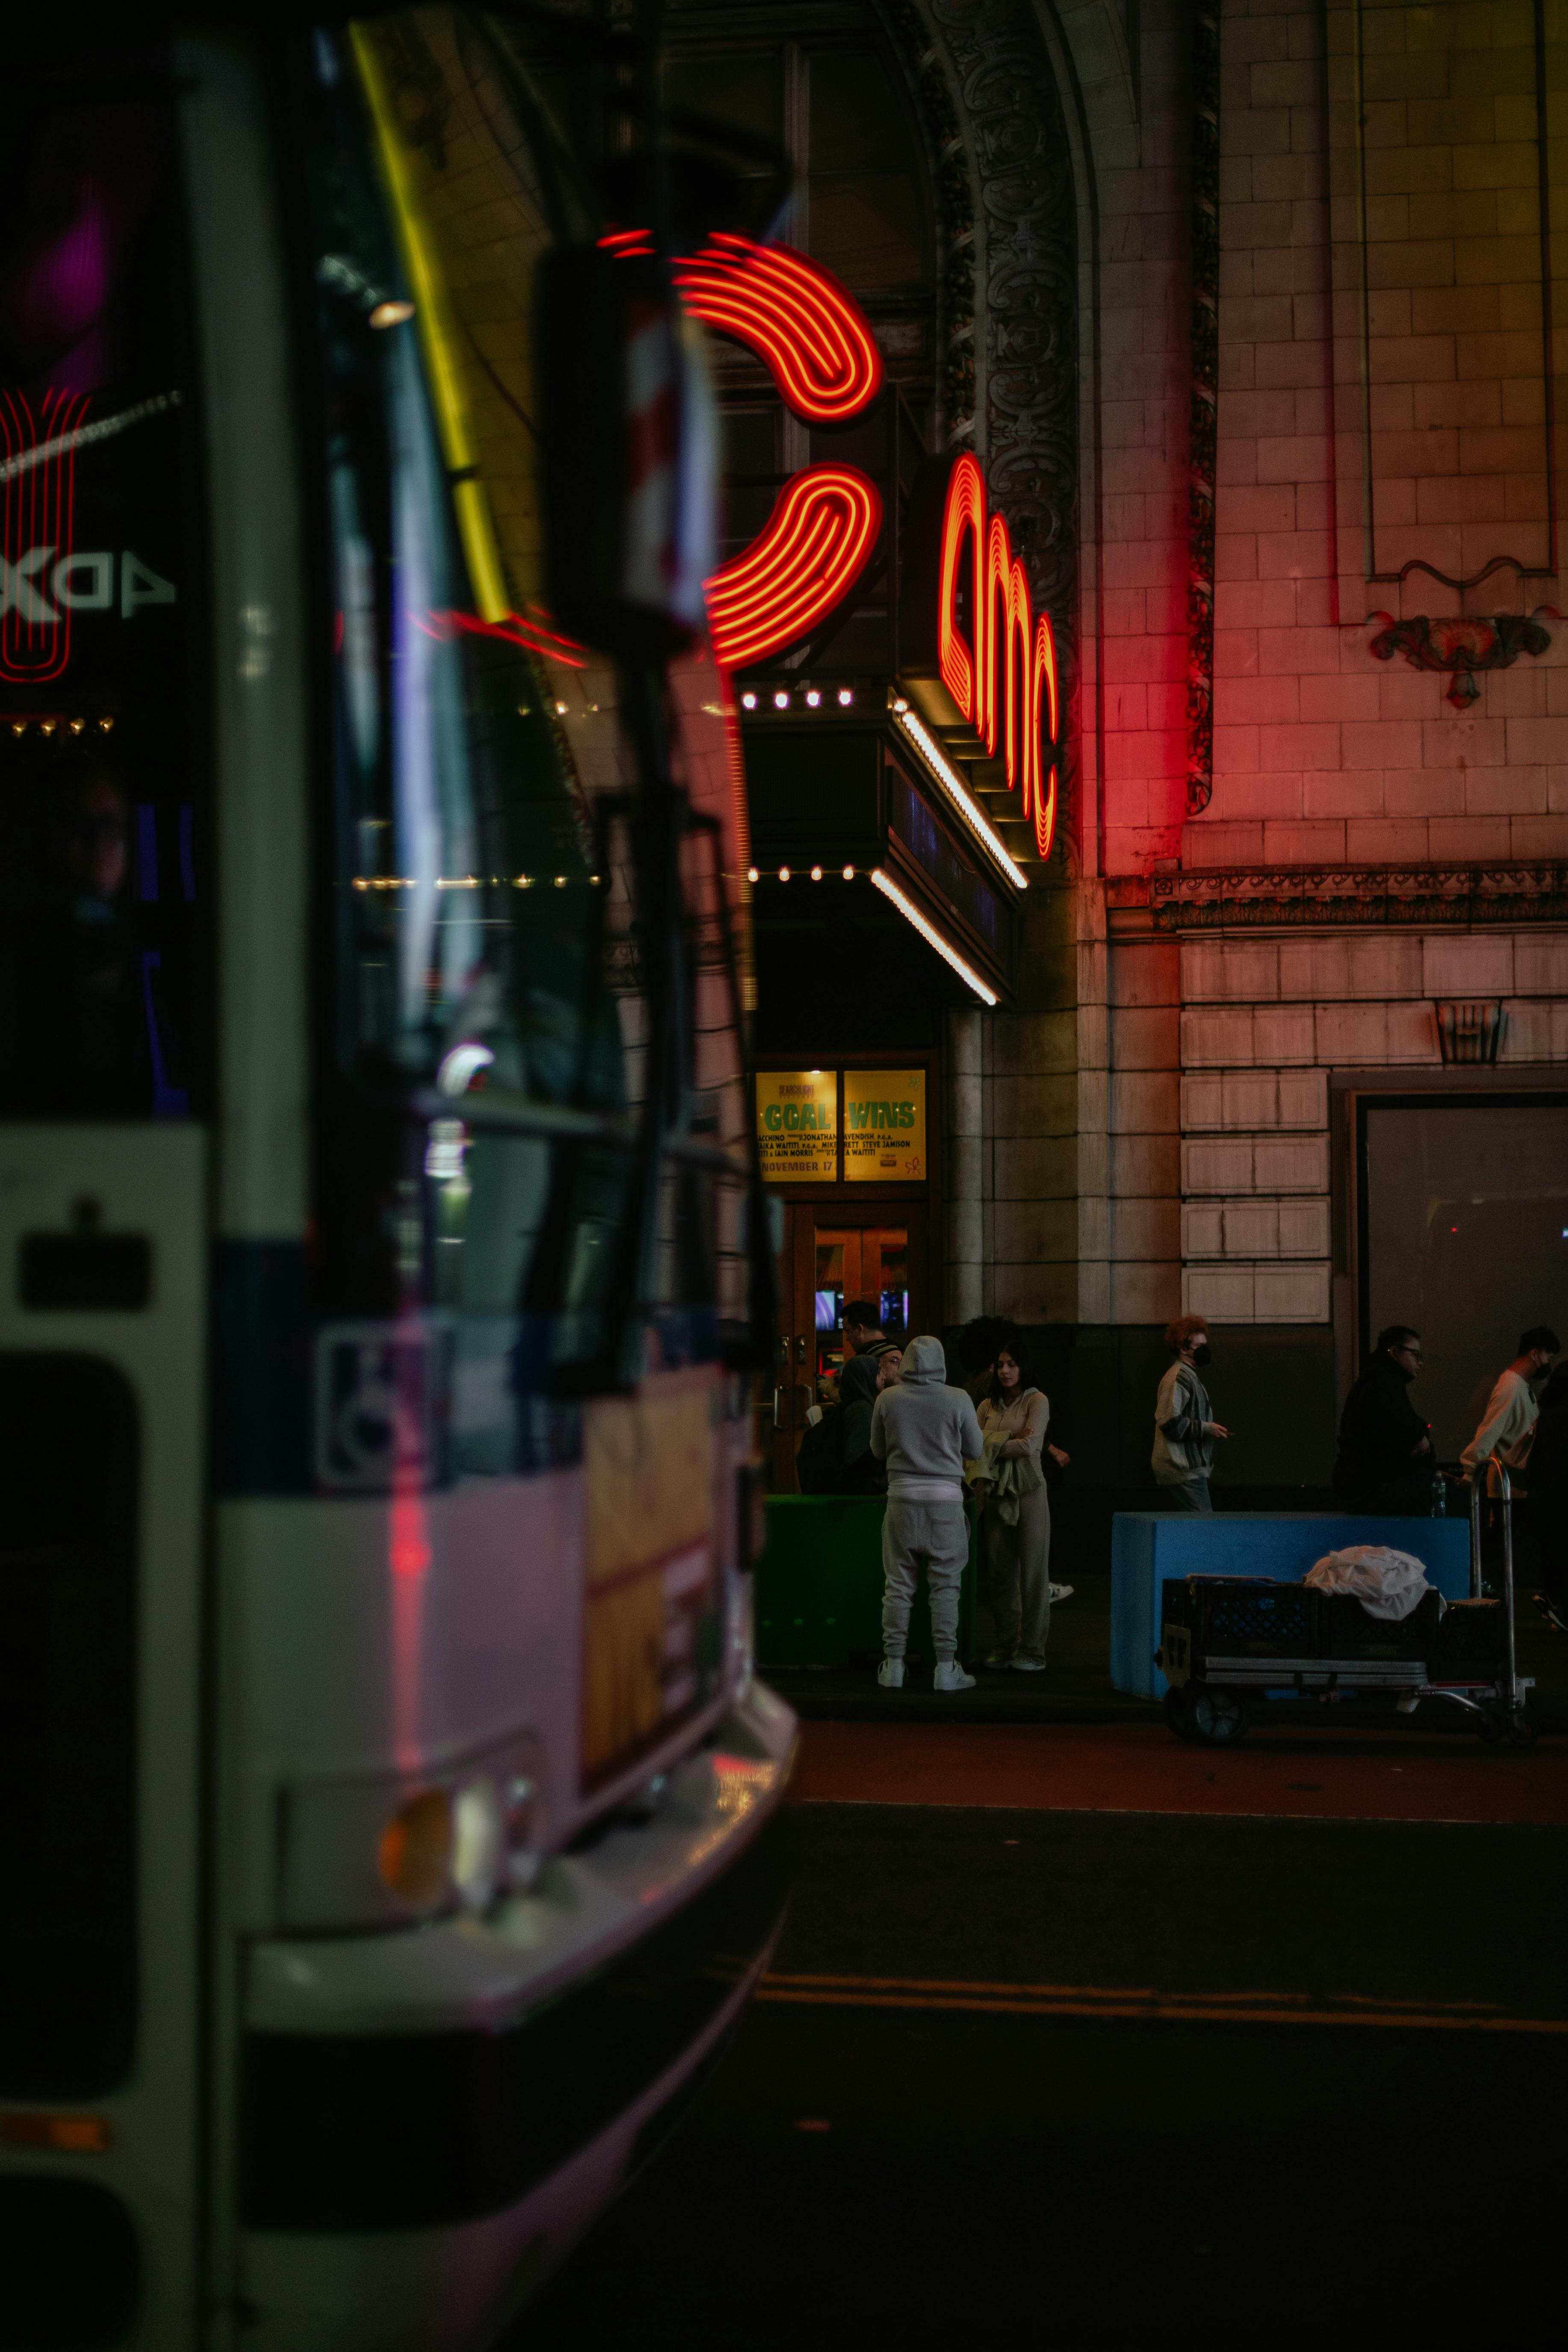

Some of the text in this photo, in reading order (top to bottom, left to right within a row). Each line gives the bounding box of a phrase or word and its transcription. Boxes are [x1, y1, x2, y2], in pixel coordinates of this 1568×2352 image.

[779, 1085, 814, 1095] SEARCHLIGHT
[764, 1101, 915, 1131] GOAL WINS
[762, 1161, 833, 1172] NOVEMBER 17
